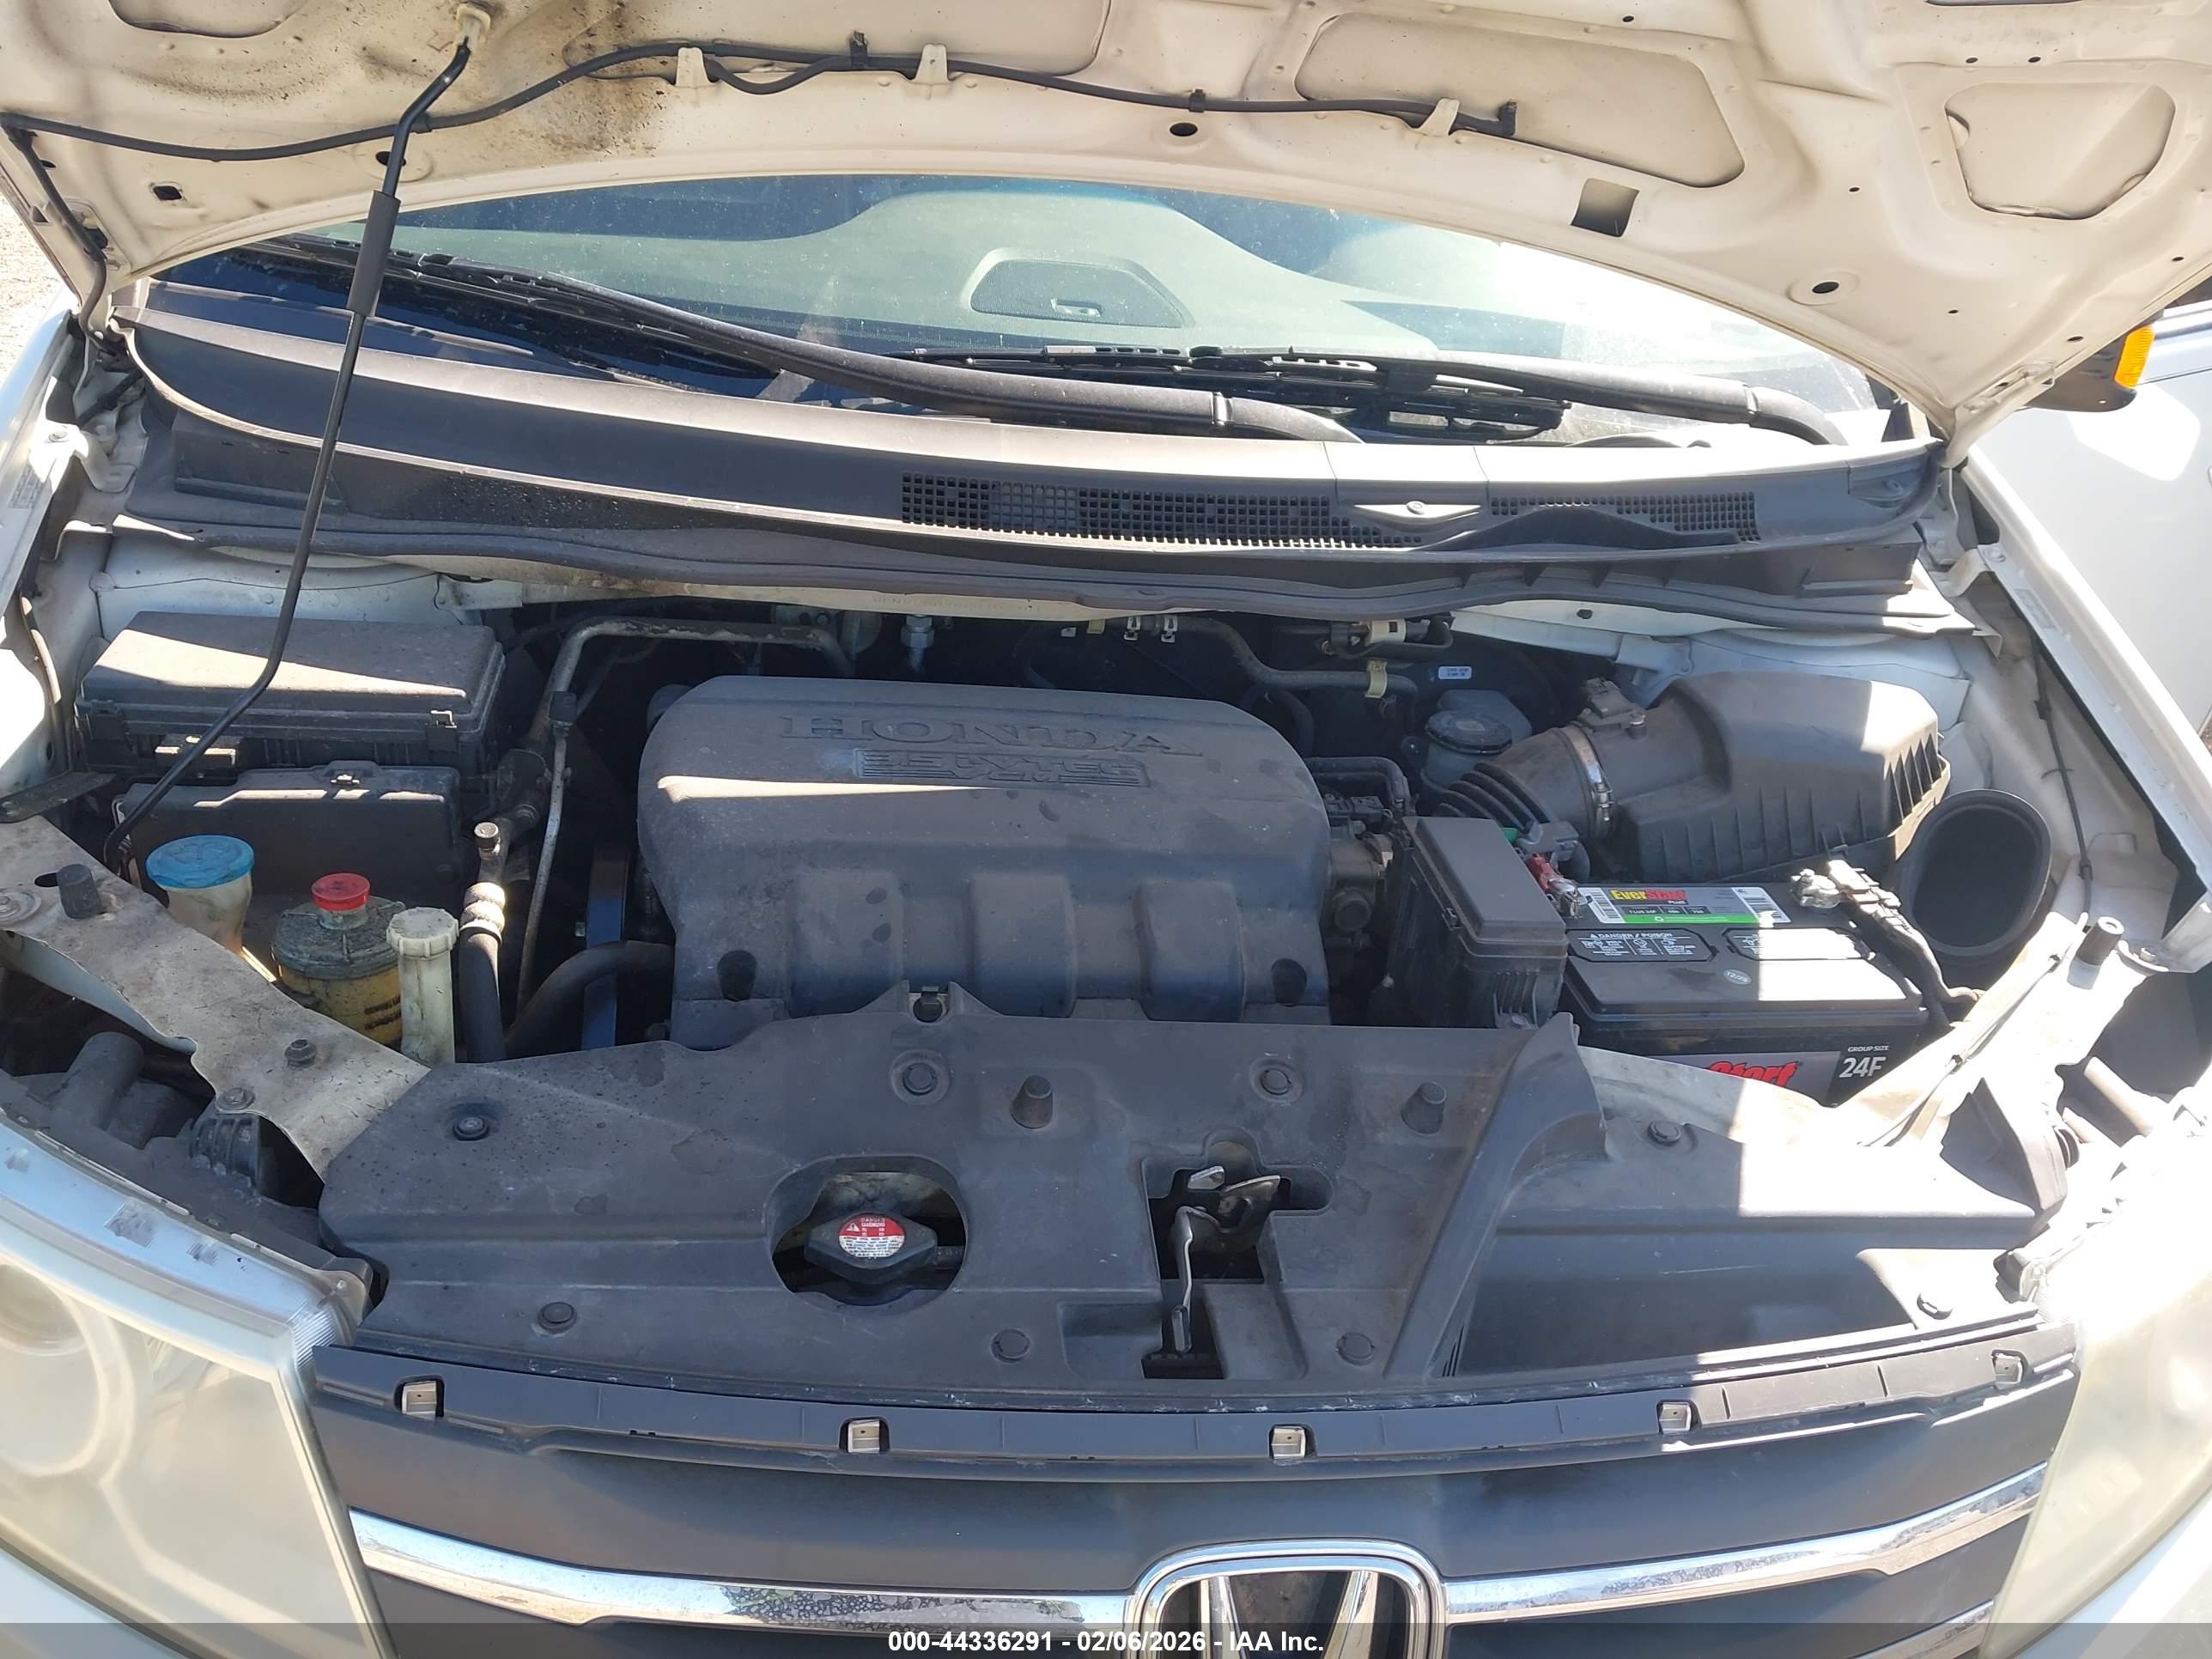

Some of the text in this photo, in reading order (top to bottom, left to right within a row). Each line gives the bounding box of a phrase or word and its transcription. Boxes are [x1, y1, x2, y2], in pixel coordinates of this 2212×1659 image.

[779, 716, 1202, 757] HONDA
[1609, 889, 1687, 900] EverStart
[1838, 1056, 1887, 1079] 24F
